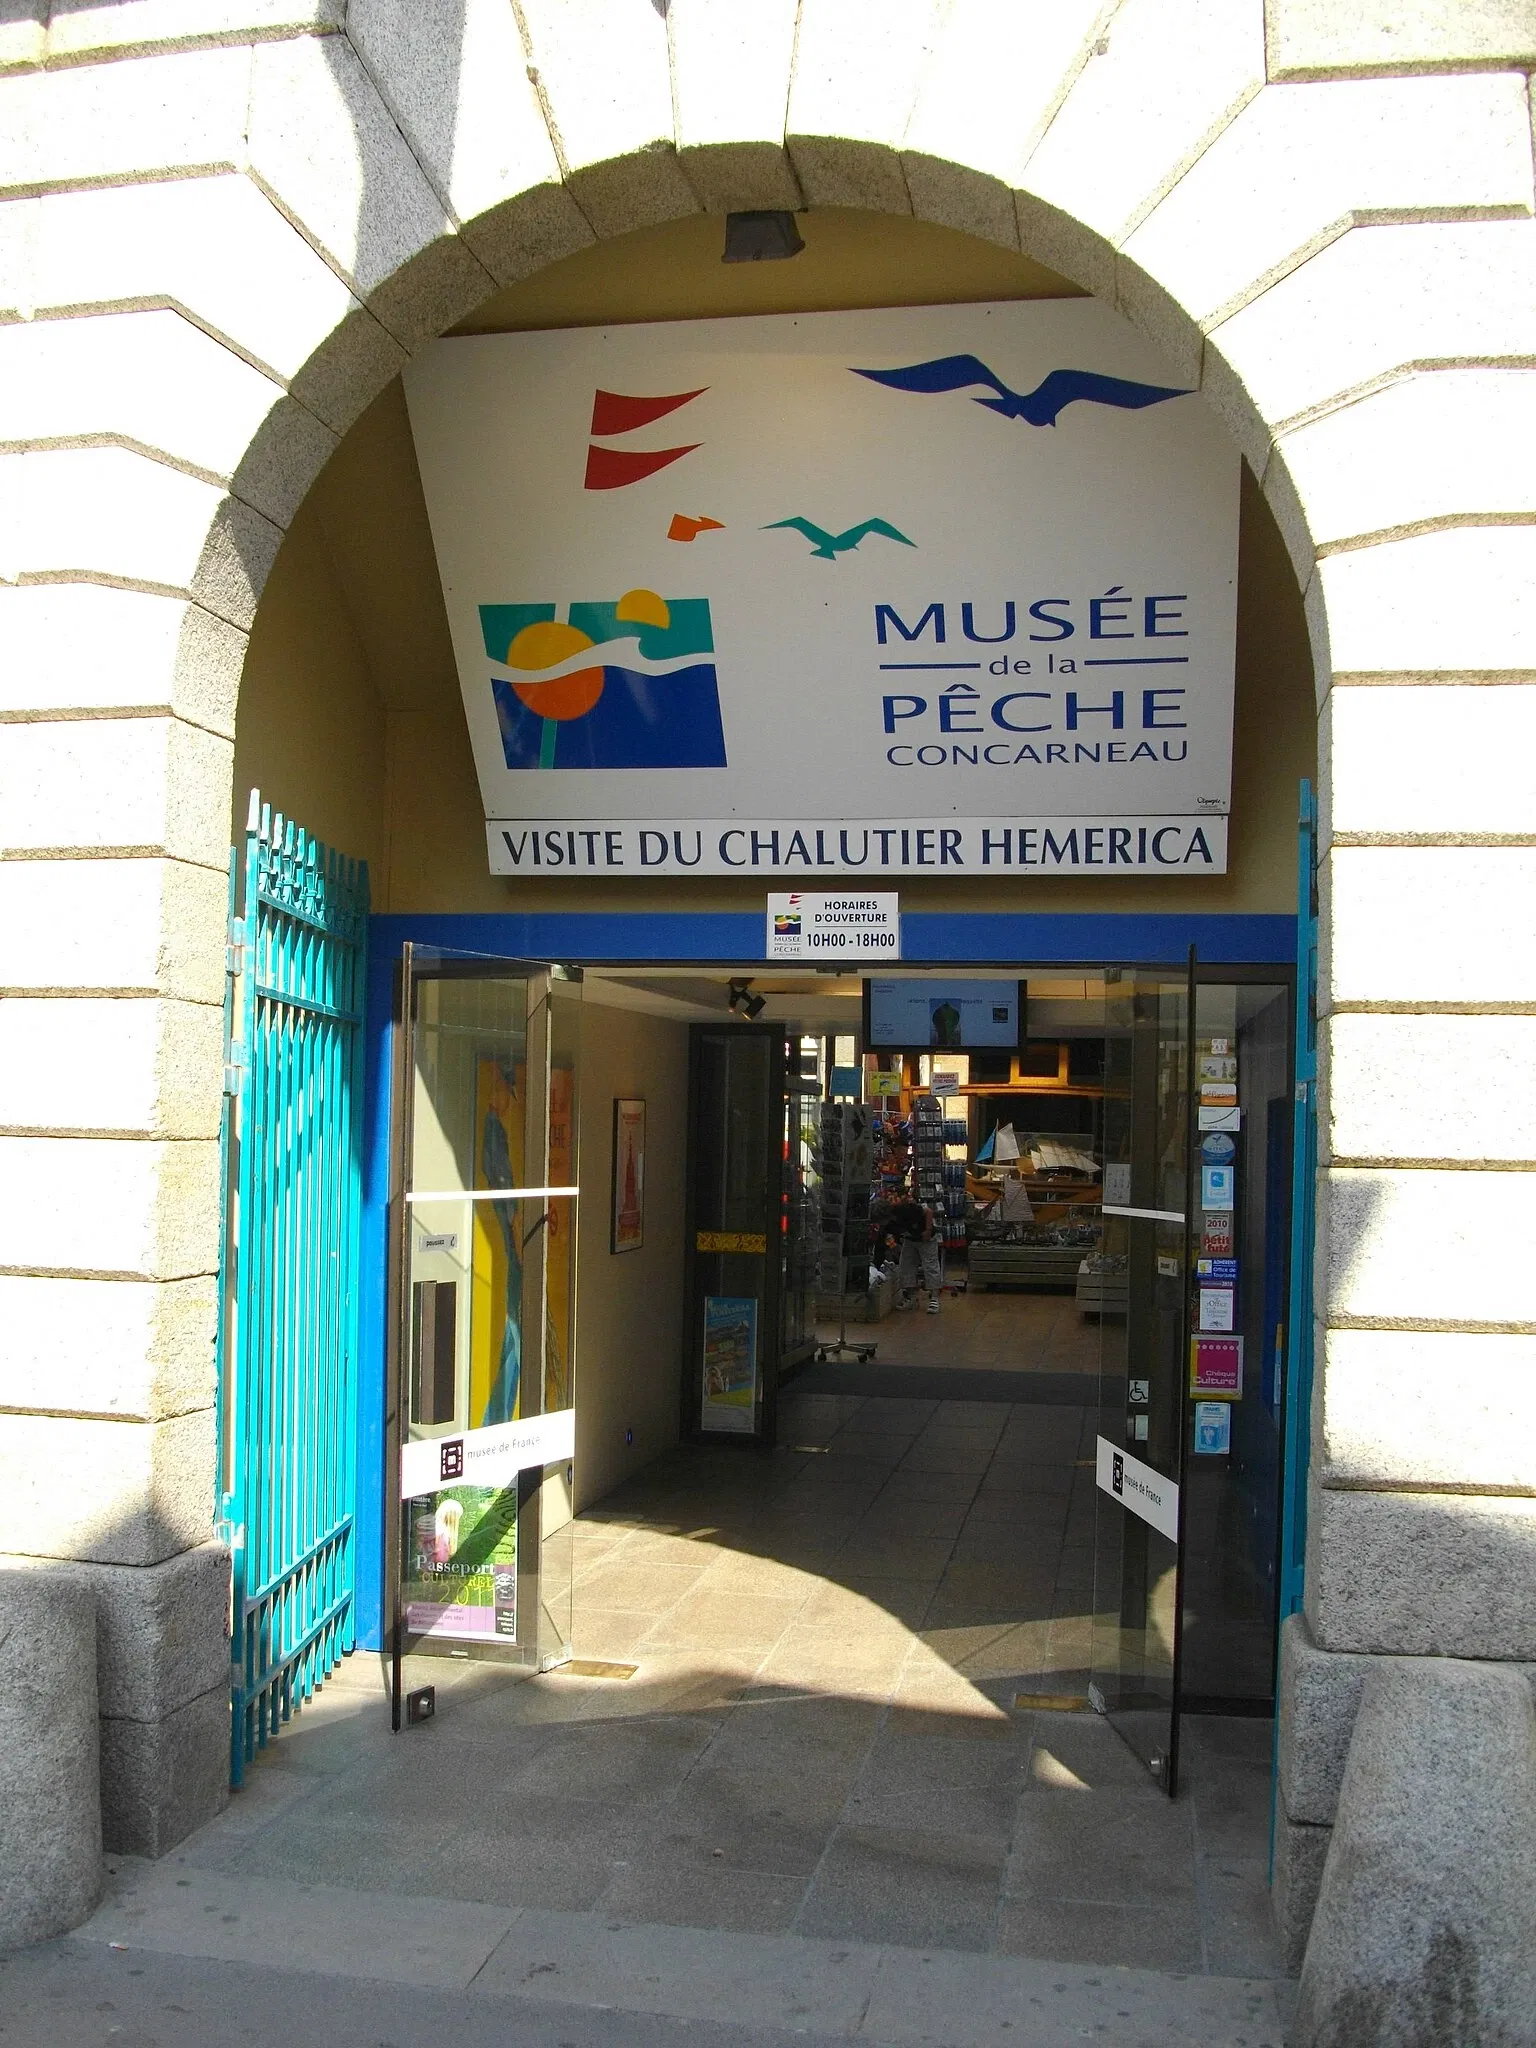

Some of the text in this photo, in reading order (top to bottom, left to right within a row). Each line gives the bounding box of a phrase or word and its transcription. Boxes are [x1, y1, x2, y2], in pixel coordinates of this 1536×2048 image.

[874, 586, 1189, 645] MUSÉE
[988, 654, 1078, 676] de la
[882, 684, 1188, 734] PÊCHE
[886, 740, 1189, 767] CONCARNEAU
[501, 826, 1213, 866] VISITE DU CHALUTIER HEMERICA
[824, 901, 878, 910] HORAIRES
[814, 913, 888, 923] D'OUVERTURE
[807, 933, 846, 947] 10H00
[855, 933, 895, 947] 18H00
[1207, 1219, 1228, 1228] 2010
[1192, 1376, 1236, 1385] Culture
[498, 1442, 510, 1453] de
[512, 1436, 541, 1449] France
[1139, 1482, 1145, 1496] de
[1145, 1485, 1161, 1506] France
[416, 1554, 495, 1577] Passeport
[422, 1571, 494, 1587] CULTUREL
